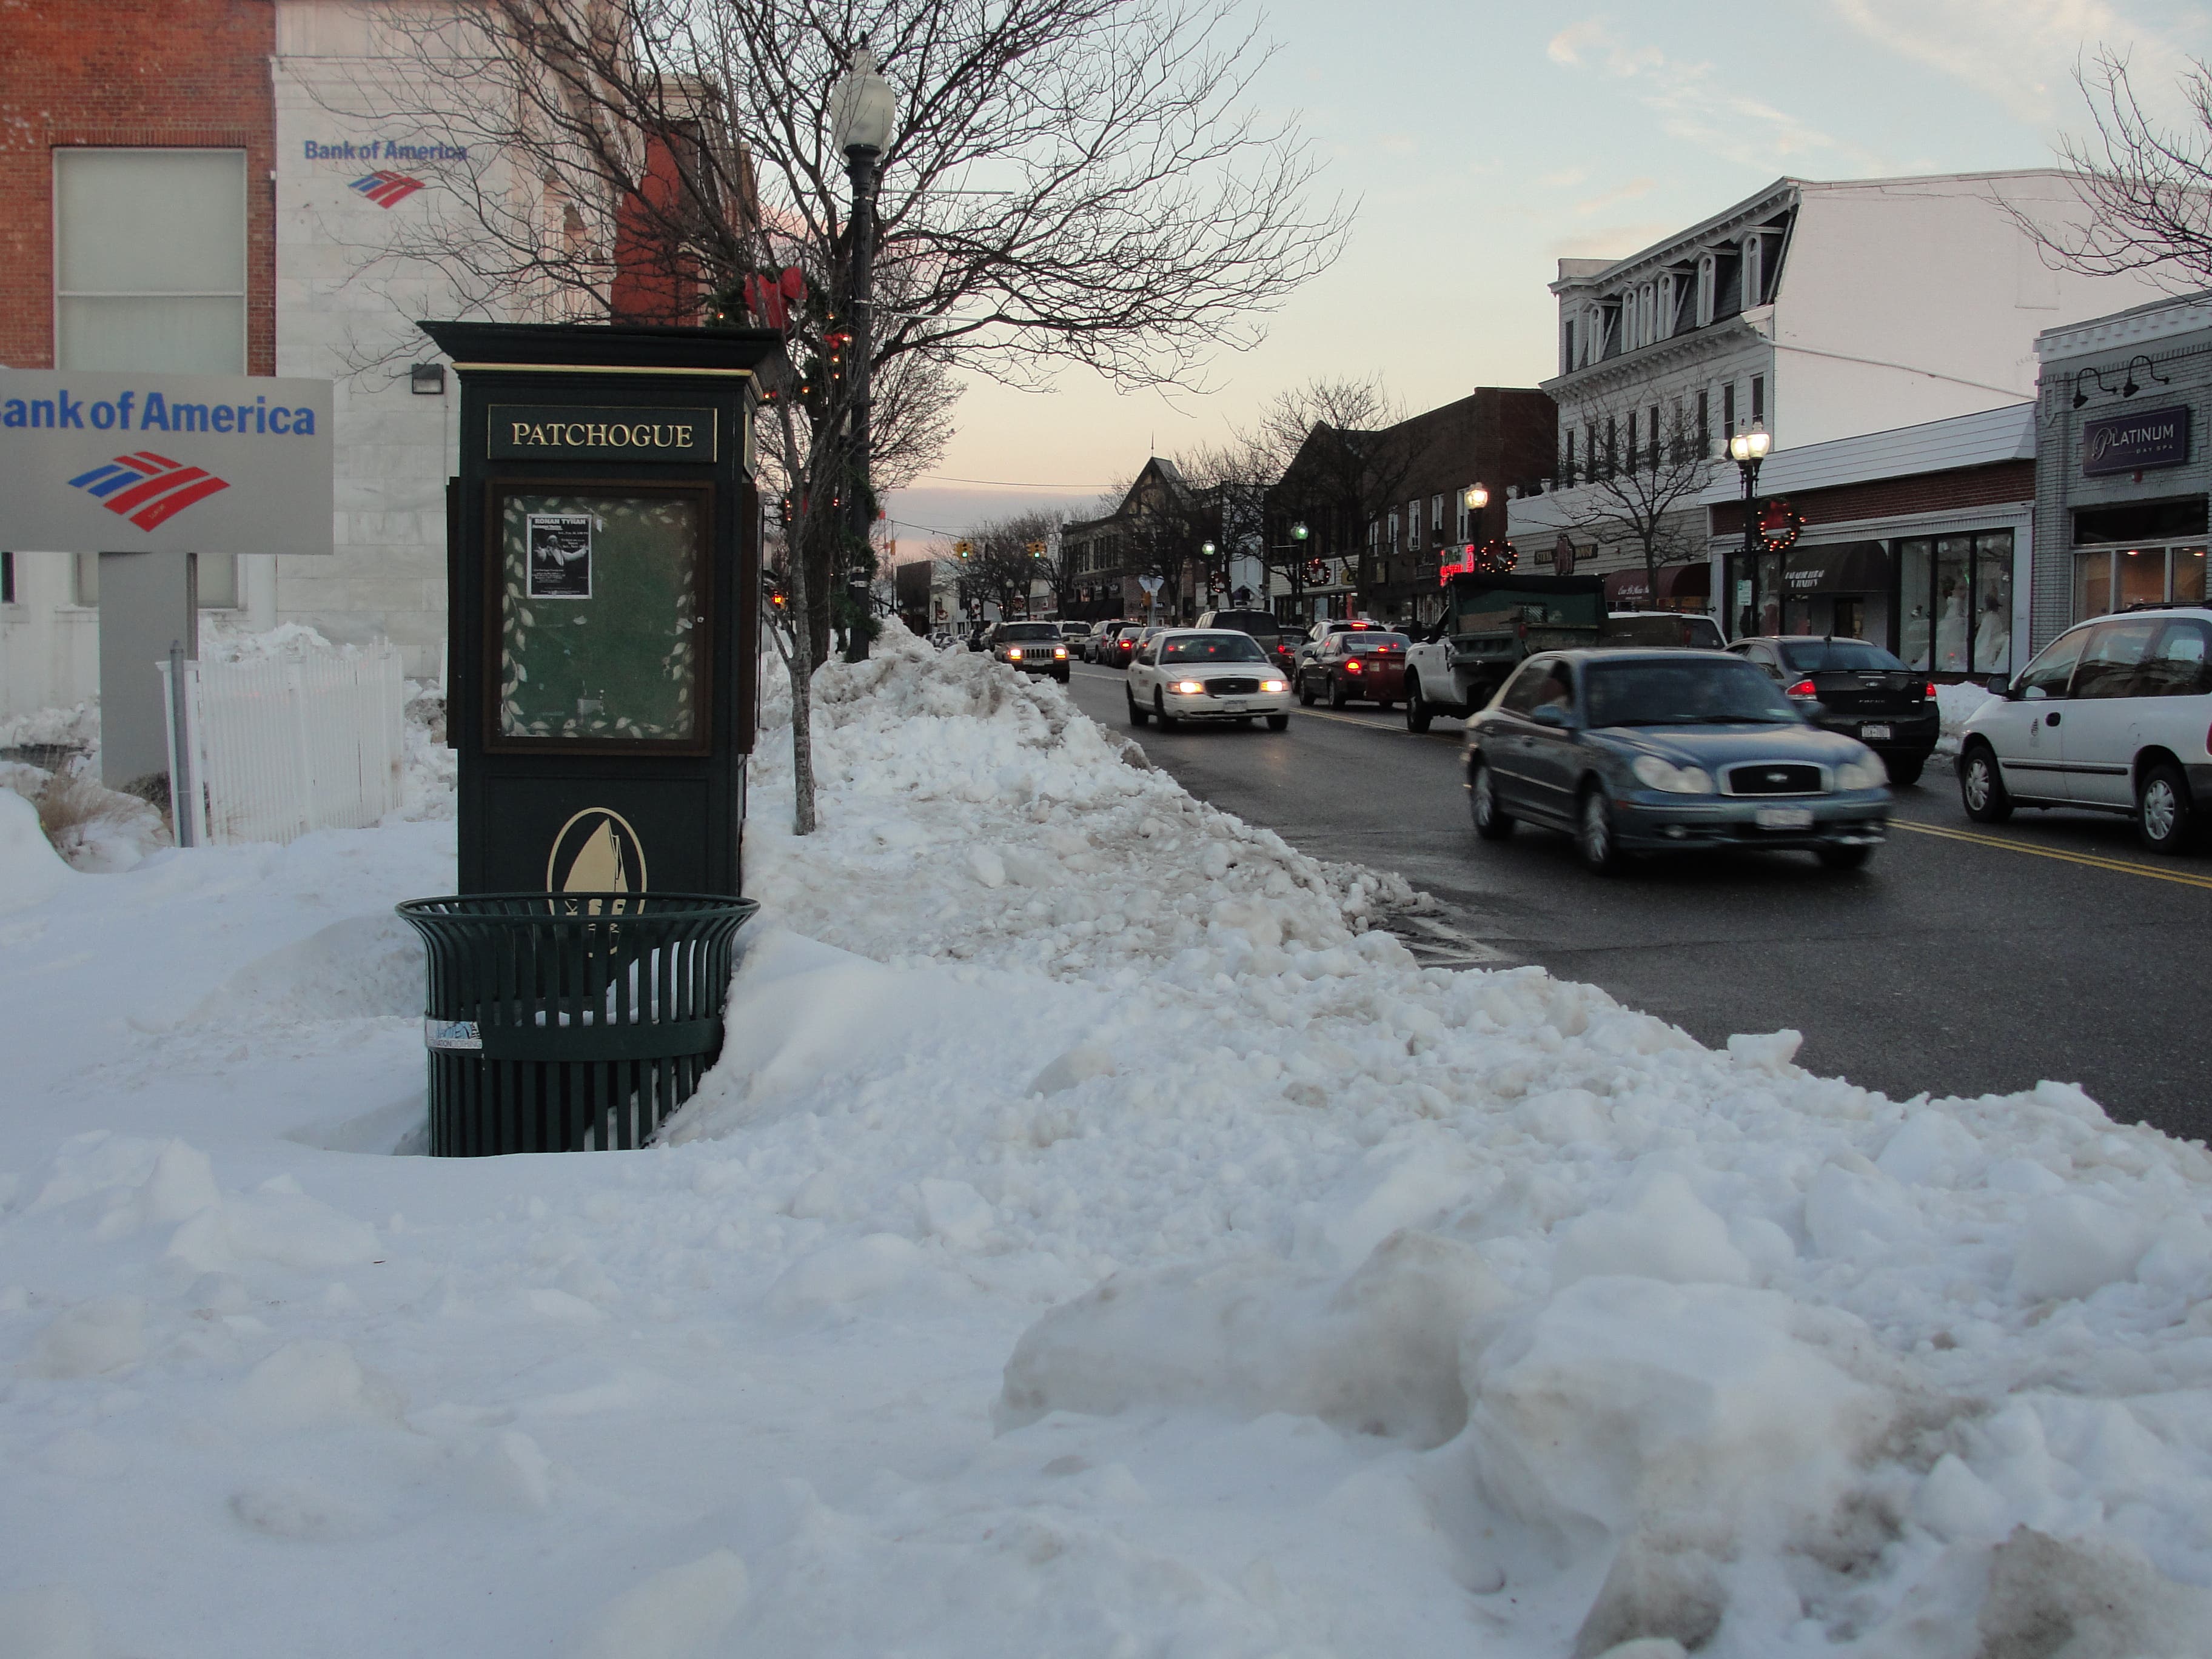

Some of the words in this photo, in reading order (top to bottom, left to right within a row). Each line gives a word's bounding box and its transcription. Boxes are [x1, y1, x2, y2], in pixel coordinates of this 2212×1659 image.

[304, 140, 344, 159] Bank
[358, 139, 380, 159] of
[384, 140, 468, 161] America
[0, 389, 84, 429] ank
[90, 390, 135, 430] of
[140, 392, 315, 435] America
[511, 422, 694, 448] PATCHOGUE
[2092, 424, 2174, 461] PLATINUM
